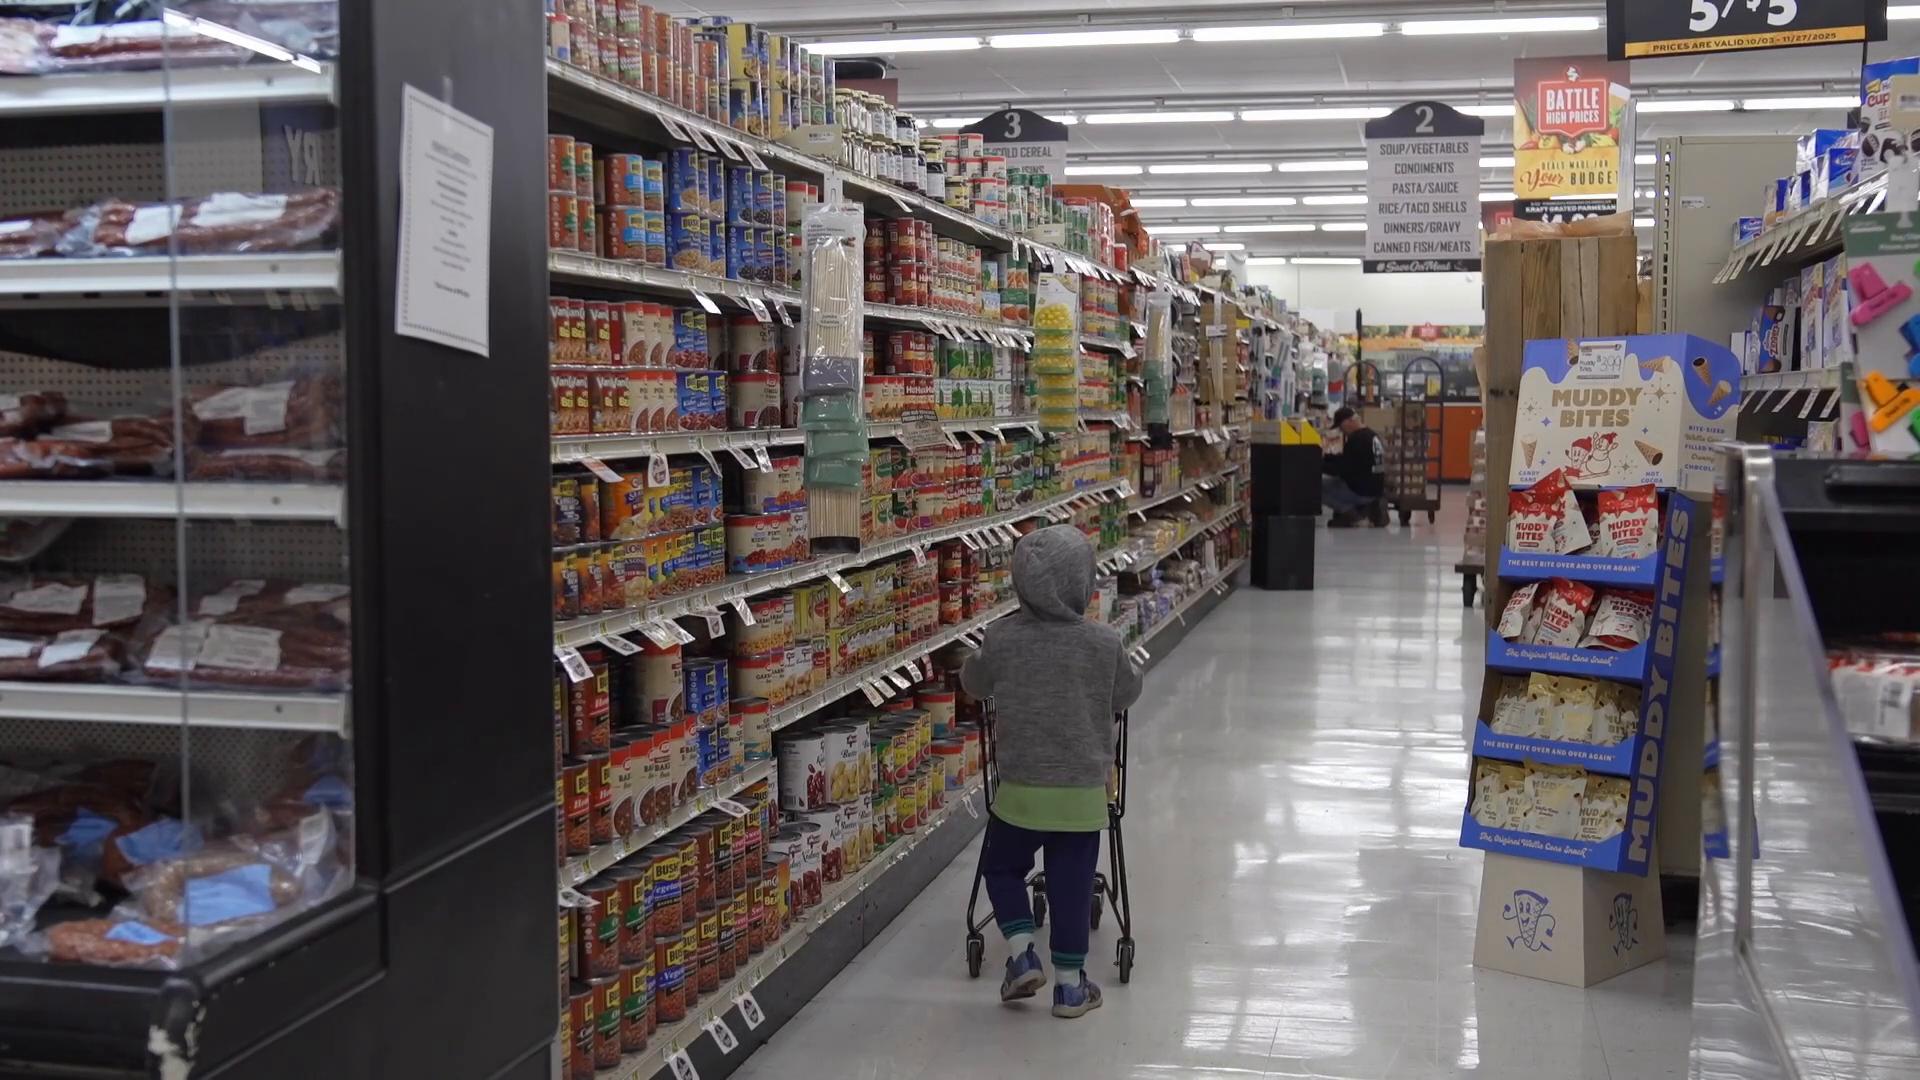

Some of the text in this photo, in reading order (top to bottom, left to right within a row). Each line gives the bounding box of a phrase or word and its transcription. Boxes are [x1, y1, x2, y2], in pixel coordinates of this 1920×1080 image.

[1653, 42, 1689, 52] PRICES
[1692, 41, 1712, 49] ARE
[1715, 39, 1744, 47] VALID
[1747, 37, 1774, 45] 10/03
[1546, 88, 1599, 110] BATTLE
[1416, 106, 1434, 133] 2
[1546, 110, 1600, 125] HIGH PRICES
[1004, 112, 1022, 138] 3
[1020, 146, 1052, 158] CEREAL
[1380, 142, 1469, 155] SOUP/VEGETABLES
[1395, 162, 1454, 174] CONDIMENTS
[1541, 161, 1565, 171] DEALS
[1569, 160, 1590, 169] MADE
[1520, 168, 1565, 192] Your
[1392, 182, 1459, 194] PASTA/SAUCE
[1378, 201, 1467, 215] RICE/TACO SHELLS
[1384, 221, 1461, 234] DINNERS/GRAVY
[1374, 241, 1471, 254] CANNED FISH/MEATS
[1552, 387, 1643, 407] MUDDY
[1560, 409, 1631, 428] BITES
[1515, 522, 1549, 531] MUDDY
[1608, 518, 1648, 531] MUDDY
[1516, 532, 1544, 541] BITES
[1611, 528, 1644, 539] BITES
[1556, 561, 1575, 569] OVER
[1576, 562, 1591, 570] AND
[1593, 563, 1612, 571] OVER
[1505, 648, 1519, 657] The
[1627, 508, 1689, 862] MUDDY BITES
[1483, 740, 1495, 748] THE
[1497, 741, 1513, 749] BEST
[1515, 743, 1530, 752] BITE
[1531, 745, 1550, 754] OVER
[1551, 747, 1567, 756] AND
[1568, 749, 1587, 759] OVER
[1480, 832, 1493, 842] The
